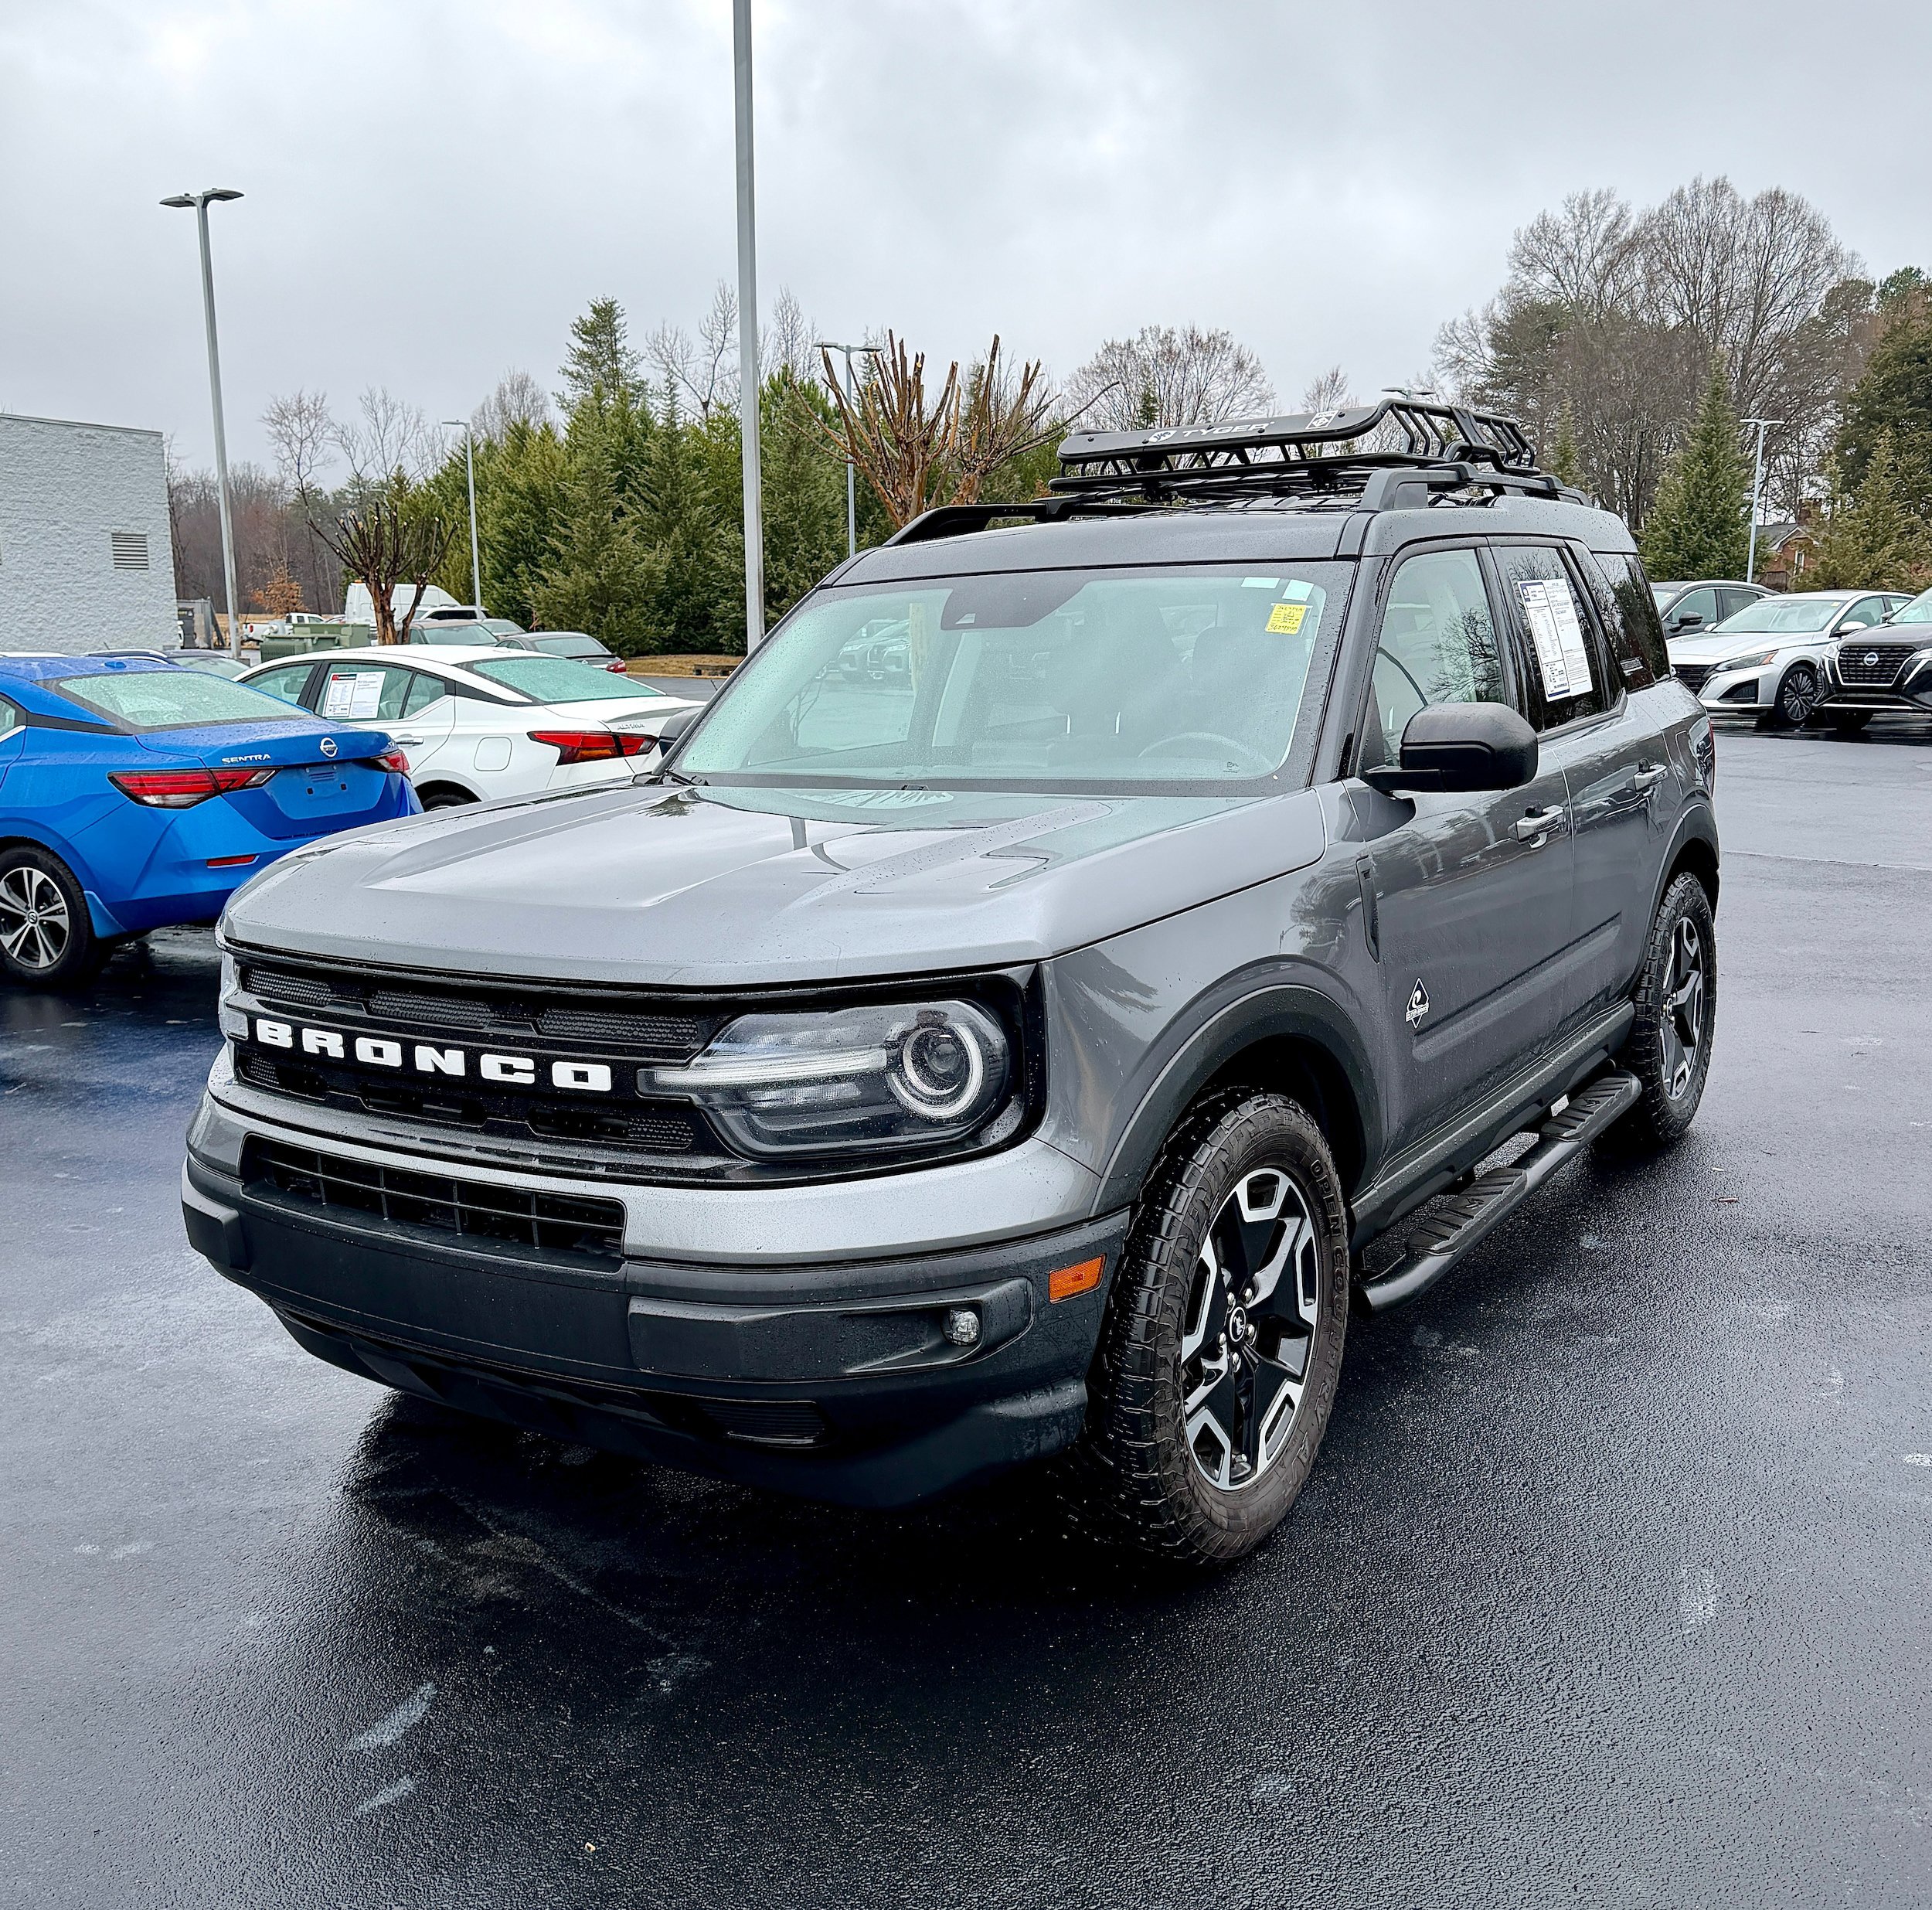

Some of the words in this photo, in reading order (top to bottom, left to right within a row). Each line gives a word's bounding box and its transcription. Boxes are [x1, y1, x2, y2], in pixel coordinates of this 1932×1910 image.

[1182, 424, 1267, 437] TYGER
[222, 754, 271, 764] SENTRA
[256, 1018, 611, 1091] BRONCO
[1311, 1159, 1342, 1237] OPEN
[1312, 1245, 1345, 1429] COUNTRY
